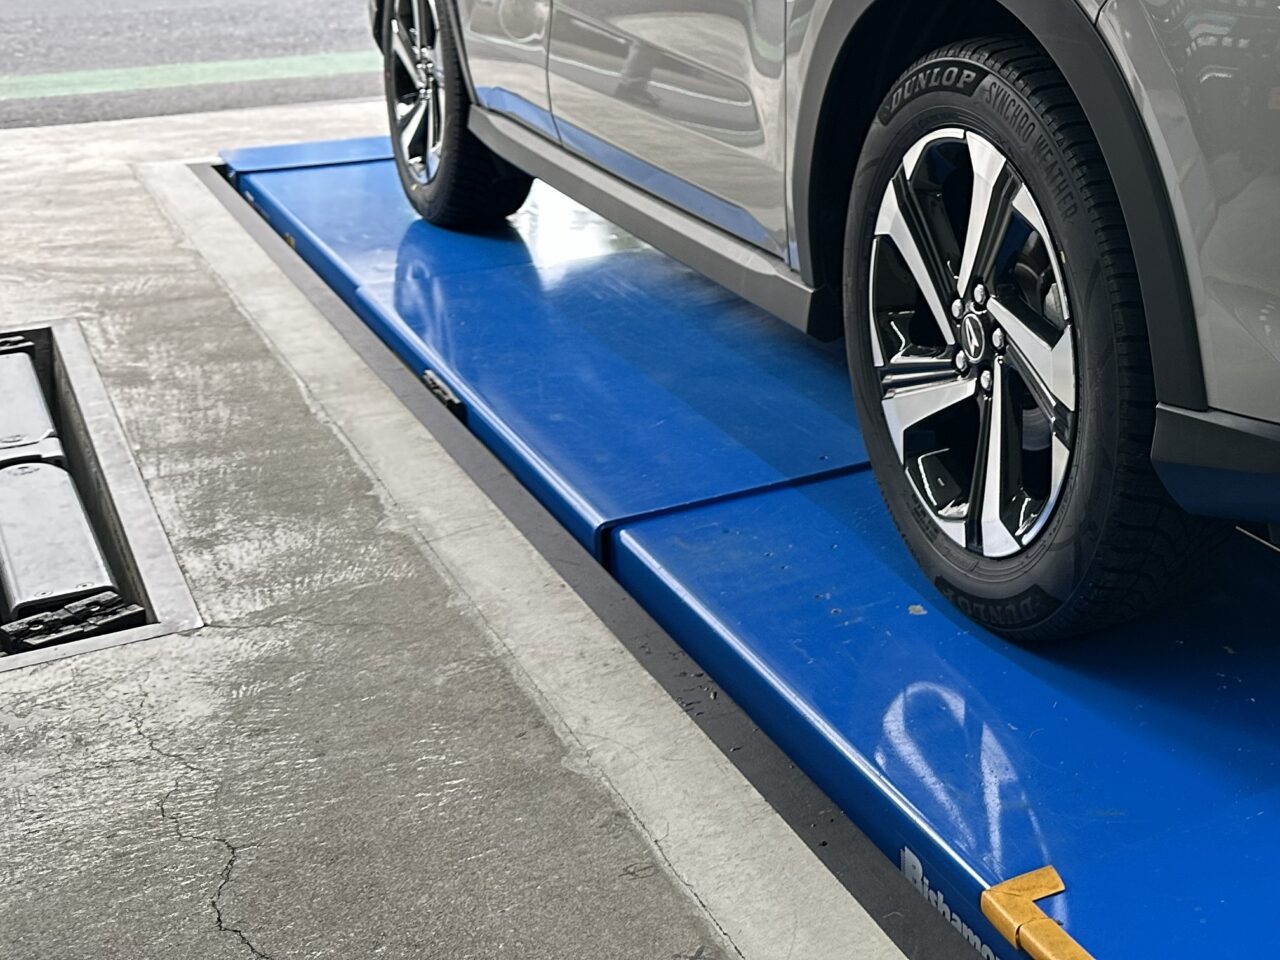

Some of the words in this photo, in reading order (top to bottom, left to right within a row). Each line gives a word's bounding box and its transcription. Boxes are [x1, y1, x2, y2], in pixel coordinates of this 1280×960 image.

[889, 66, 977, 113] DUNLOP
[985, 81, 1036, 142] SYNCHRO
[1031, 133, 1079, 223] WEATHER
